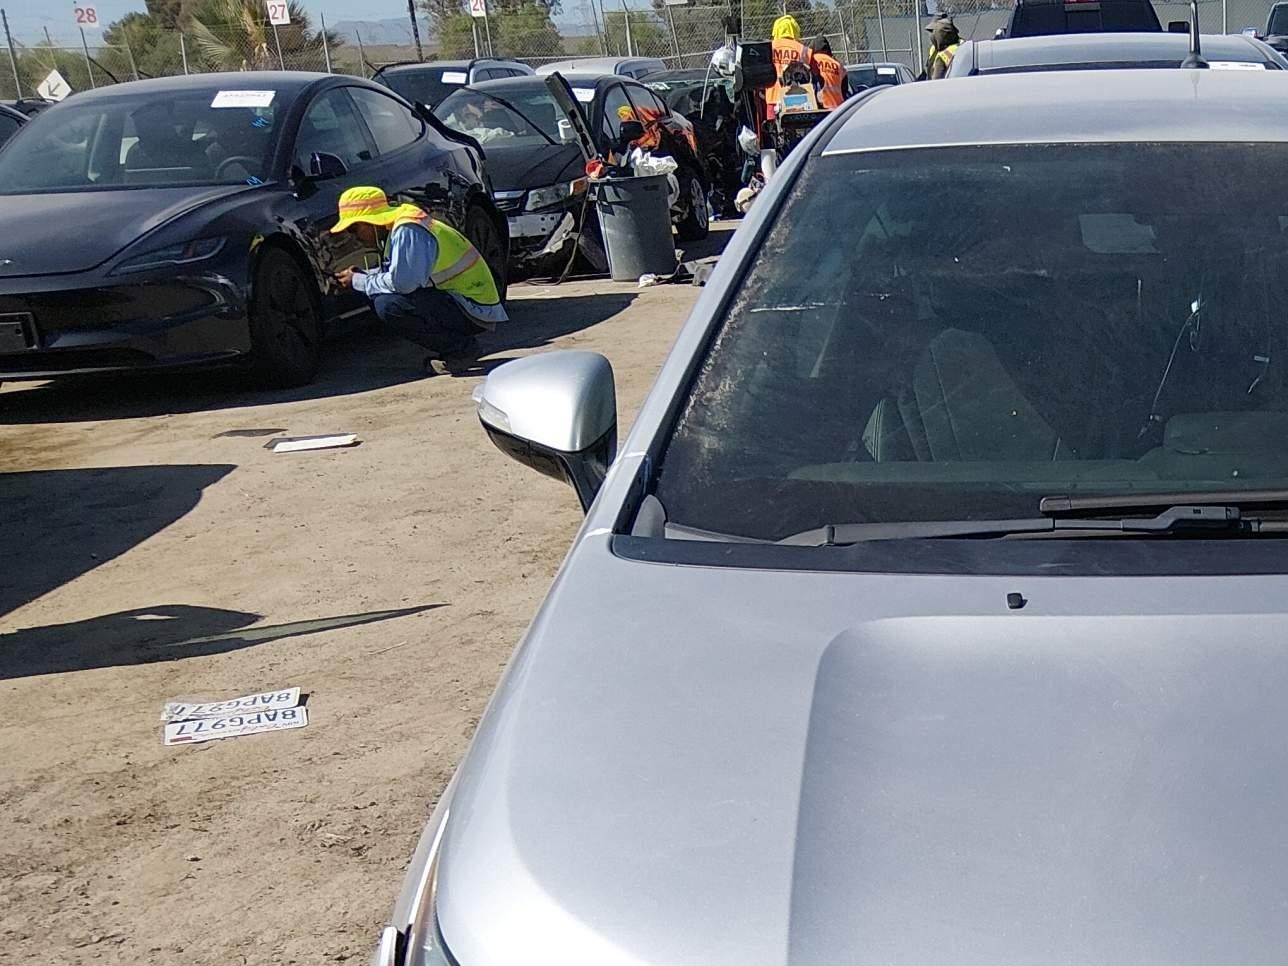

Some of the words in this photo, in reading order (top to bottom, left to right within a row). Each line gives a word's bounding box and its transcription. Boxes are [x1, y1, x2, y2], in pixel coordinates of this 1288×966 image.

[74, 8, 97, 23] 28
[270, 5, 286, 19] 27
[773, 49, 800, 60] MAD
[175, 708, 297, 736] 8APG977
